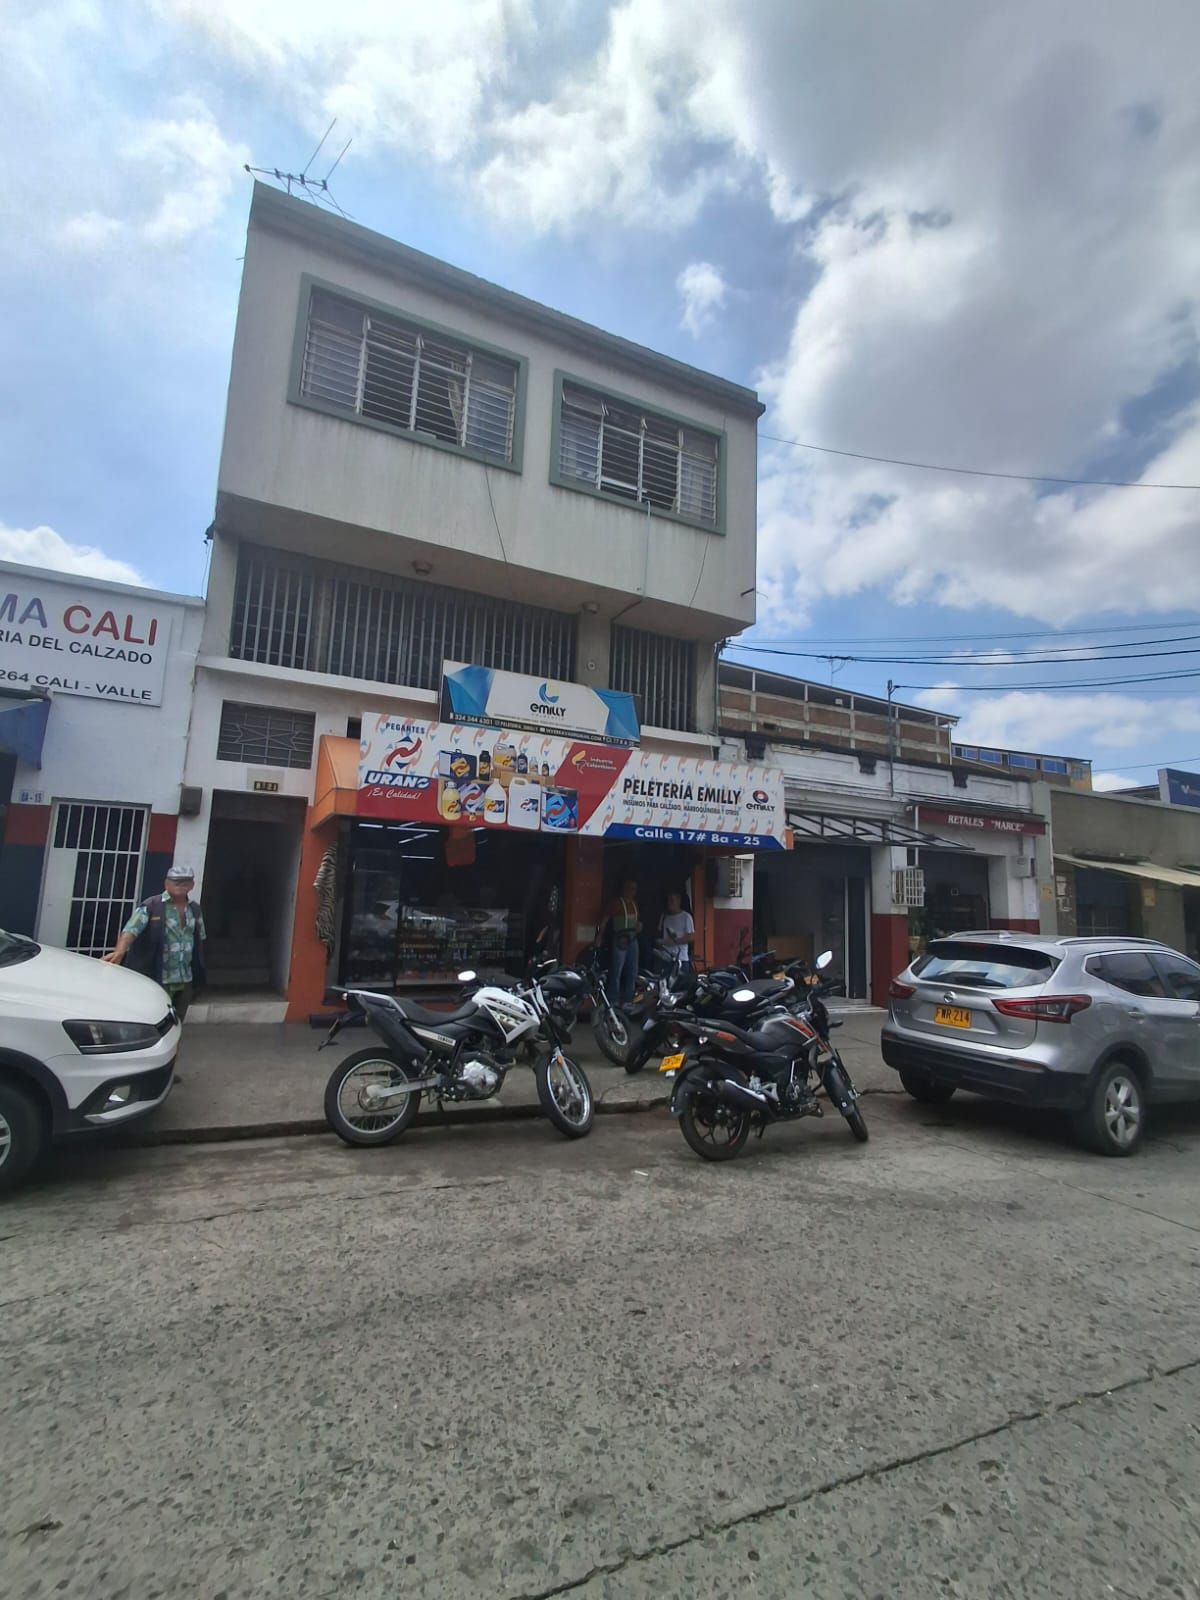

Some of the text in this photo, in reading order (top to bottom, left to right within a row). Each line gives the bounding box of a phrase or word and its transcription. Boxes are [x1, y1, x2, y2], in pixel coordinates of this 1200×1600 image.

[63, 605, 158, 646] CALI
[29, 635, 64, 651] DEL
[69, 641, 152, 665] CALZADO
[35, 675, 79, 690] CALI
[95, 683, 152, 700] VALLE
[386, 723, 425, 734] PEGANTES
[386, 789, 422, 800] Calidad!
[623, 778, 741, 805] PELETERÍA EMILLY
[647, 801, 659, 809] PARA
[948, 815, 984, 827] RETALES
[635, 827, 673, 839] Calle
[711, 833, 729, 844] 8a
[744, 836, 760, 846] 25
